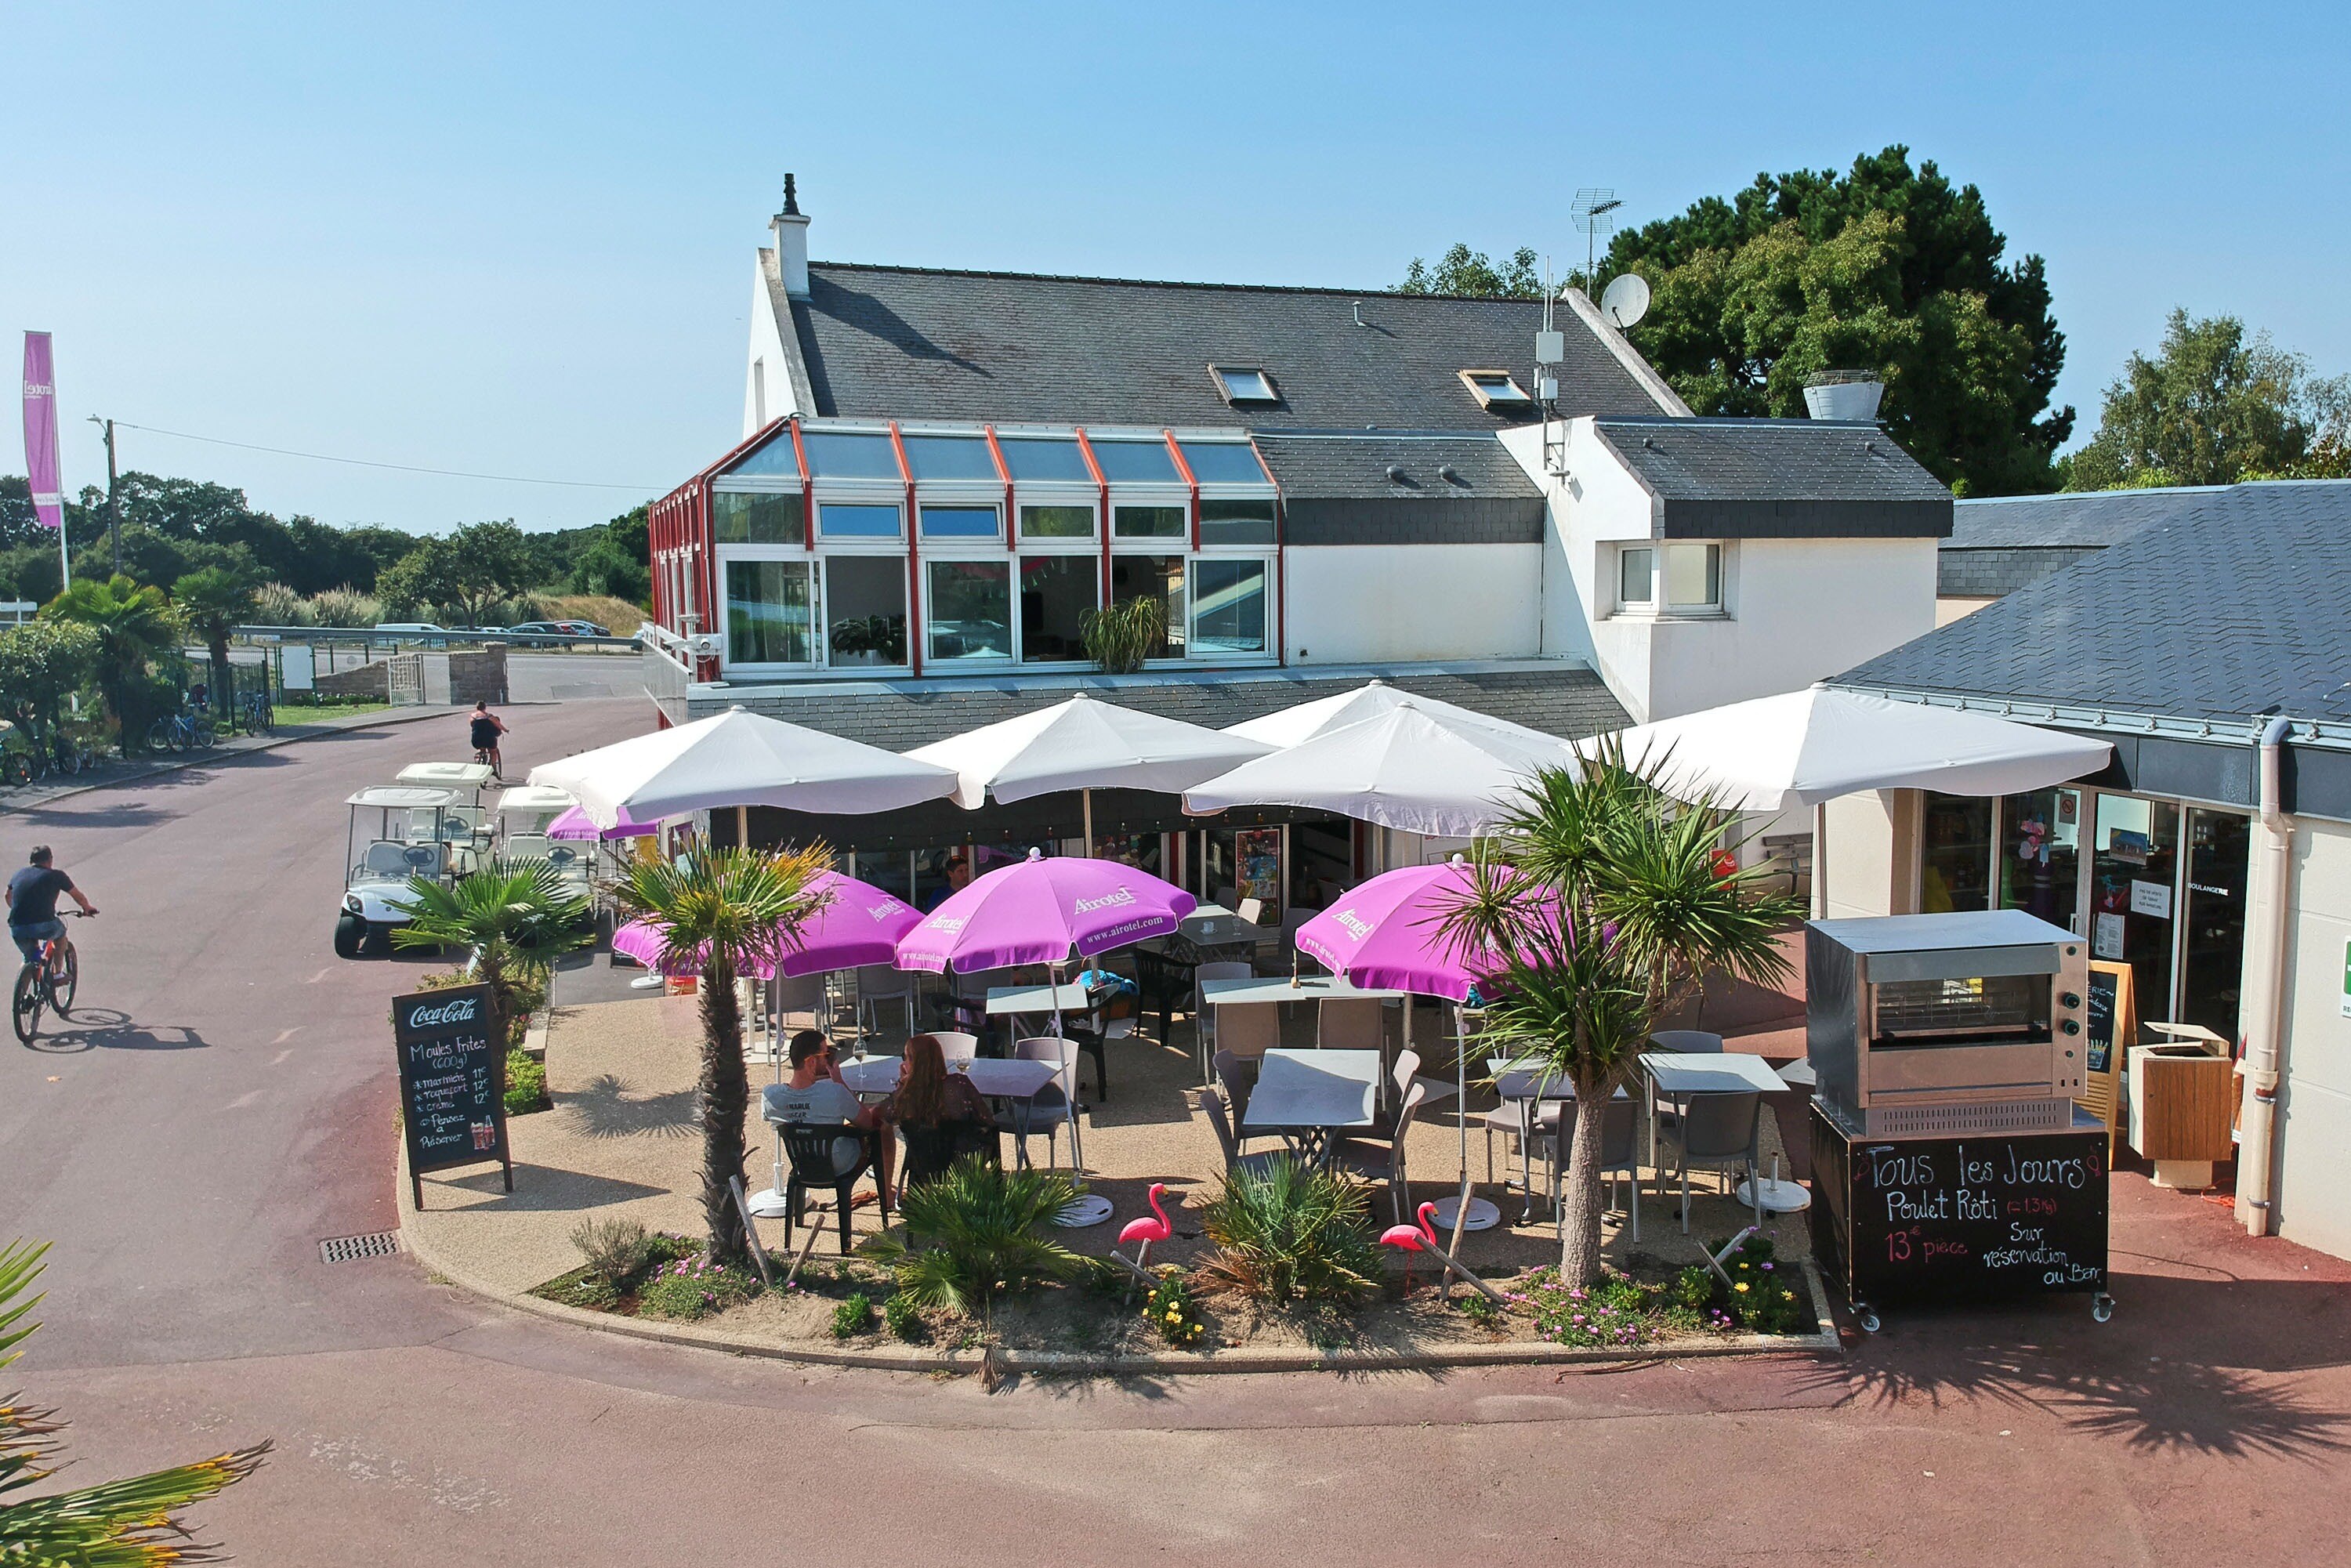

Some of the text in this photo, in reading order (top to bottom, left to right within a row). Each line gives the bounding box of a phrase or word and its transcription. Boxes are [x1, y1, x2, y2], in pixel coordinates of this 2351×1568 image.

[1074, 887, 1135, 915] Airotel
[2187, 882, 2229, 896] BOULANGERIE
[866, 897, 901, 922] Airotel
[925, 912, 969, 930] Airotel
[1087, 916, 1164, 943] www.airotel.com
[1331, 908, 1374, 938] Airotel
[410, 998, 477, 1028] Coca-Cola
[410, 1035, 487, 1062] Moules Frites
[433, 1052, 468, 1070] (600g)
[423, 1082, 469, 1102] roquefort
[431, 1114, 465, 1128] Pensez
[1867, 1144, 2085, 1189] Tous les Jours
[1886, 1189, 1948, 1222] Poulet
[1957, 1190, 1998, 1220] Rôti
[2010, 1222, 2044, 1241] Sur
[1983, 1240, 2069, 1268] réservation
[2043, 1271, 2065, 1284] au
